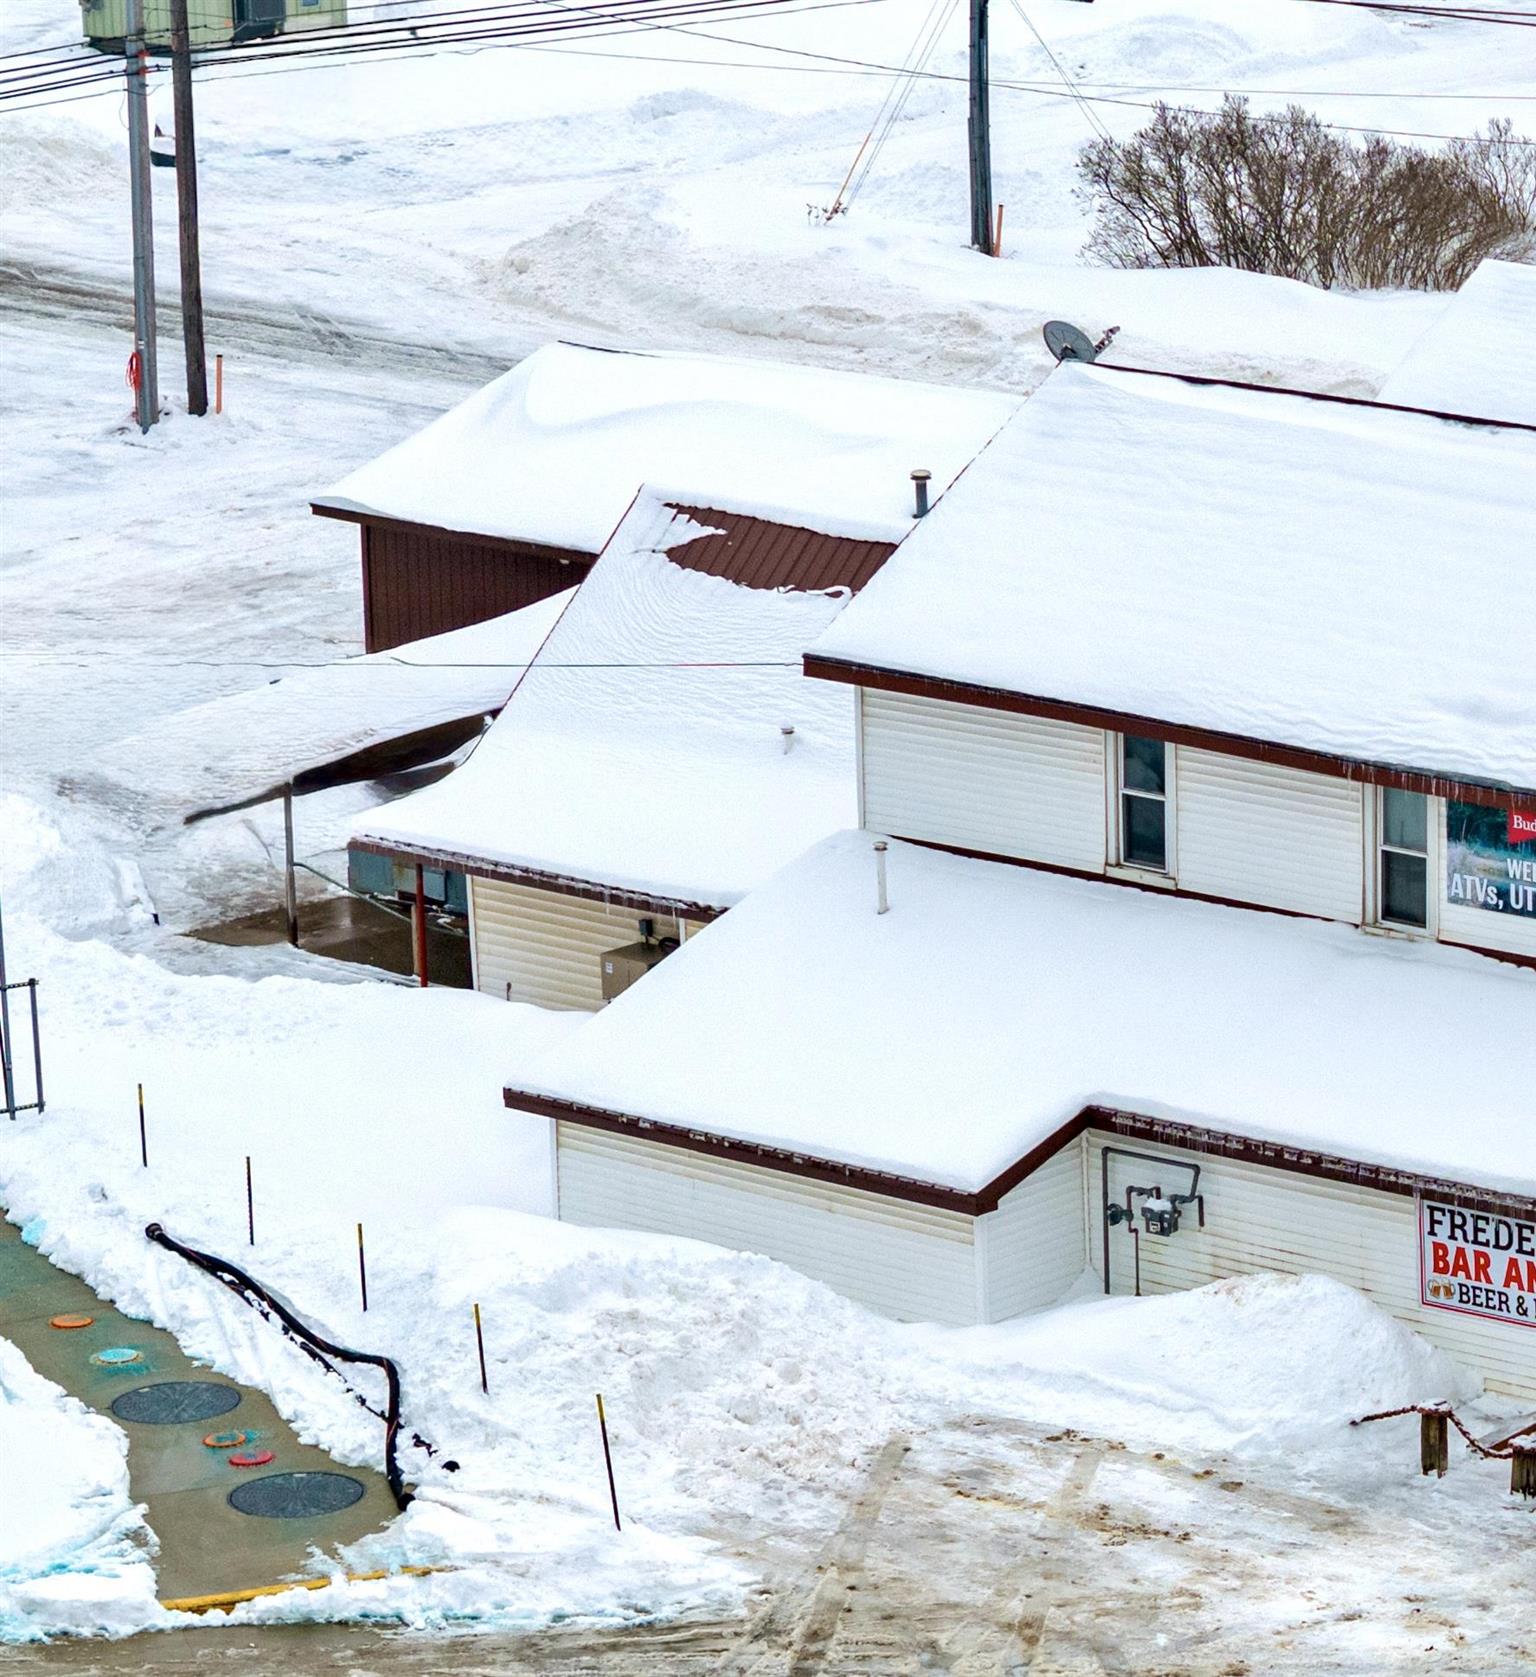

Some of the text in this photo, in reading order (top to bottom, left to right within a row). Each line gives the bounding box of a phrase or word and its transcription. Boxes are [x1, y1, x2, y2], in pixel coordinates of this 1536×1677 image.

[1450, 873, 1504, 910] ATVs,
[1432, 1241, 1493, 1285] BAR
[1457, 1283, 1511, 1314] BEER
[1516, 1296, 1528, 1317] &
